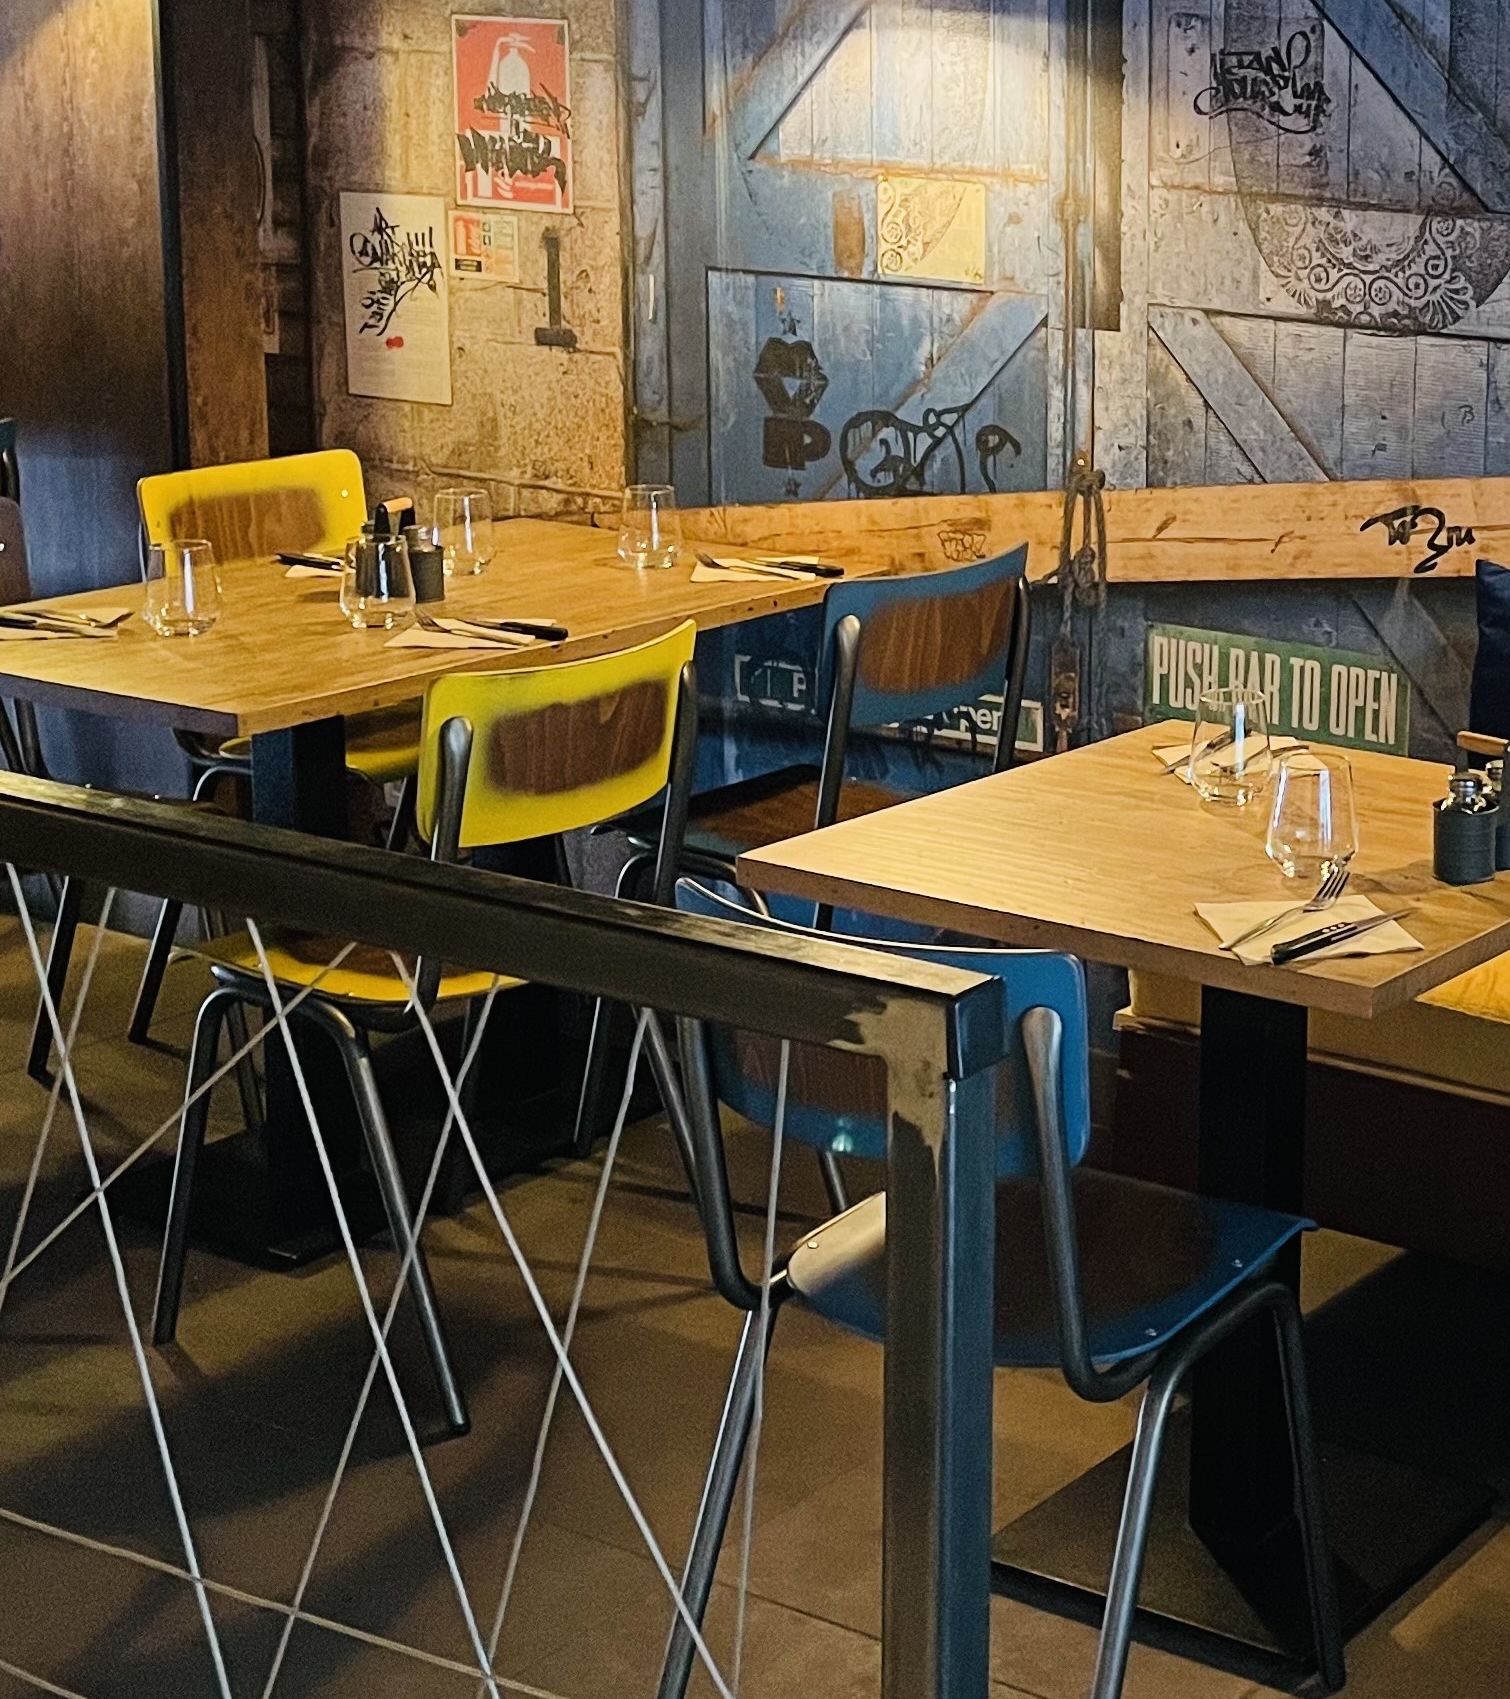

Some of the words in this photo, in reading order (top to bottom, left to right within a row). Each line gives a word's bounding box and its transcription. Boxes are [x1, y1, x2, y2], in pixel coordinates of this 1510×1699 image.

[1152, 635, 1220, 711] PUSH
[1229, 647, 1281, 726] BAR
[1289, 656, 1321, 732] TO
[1329, 663, 1398, 745] OPEN
